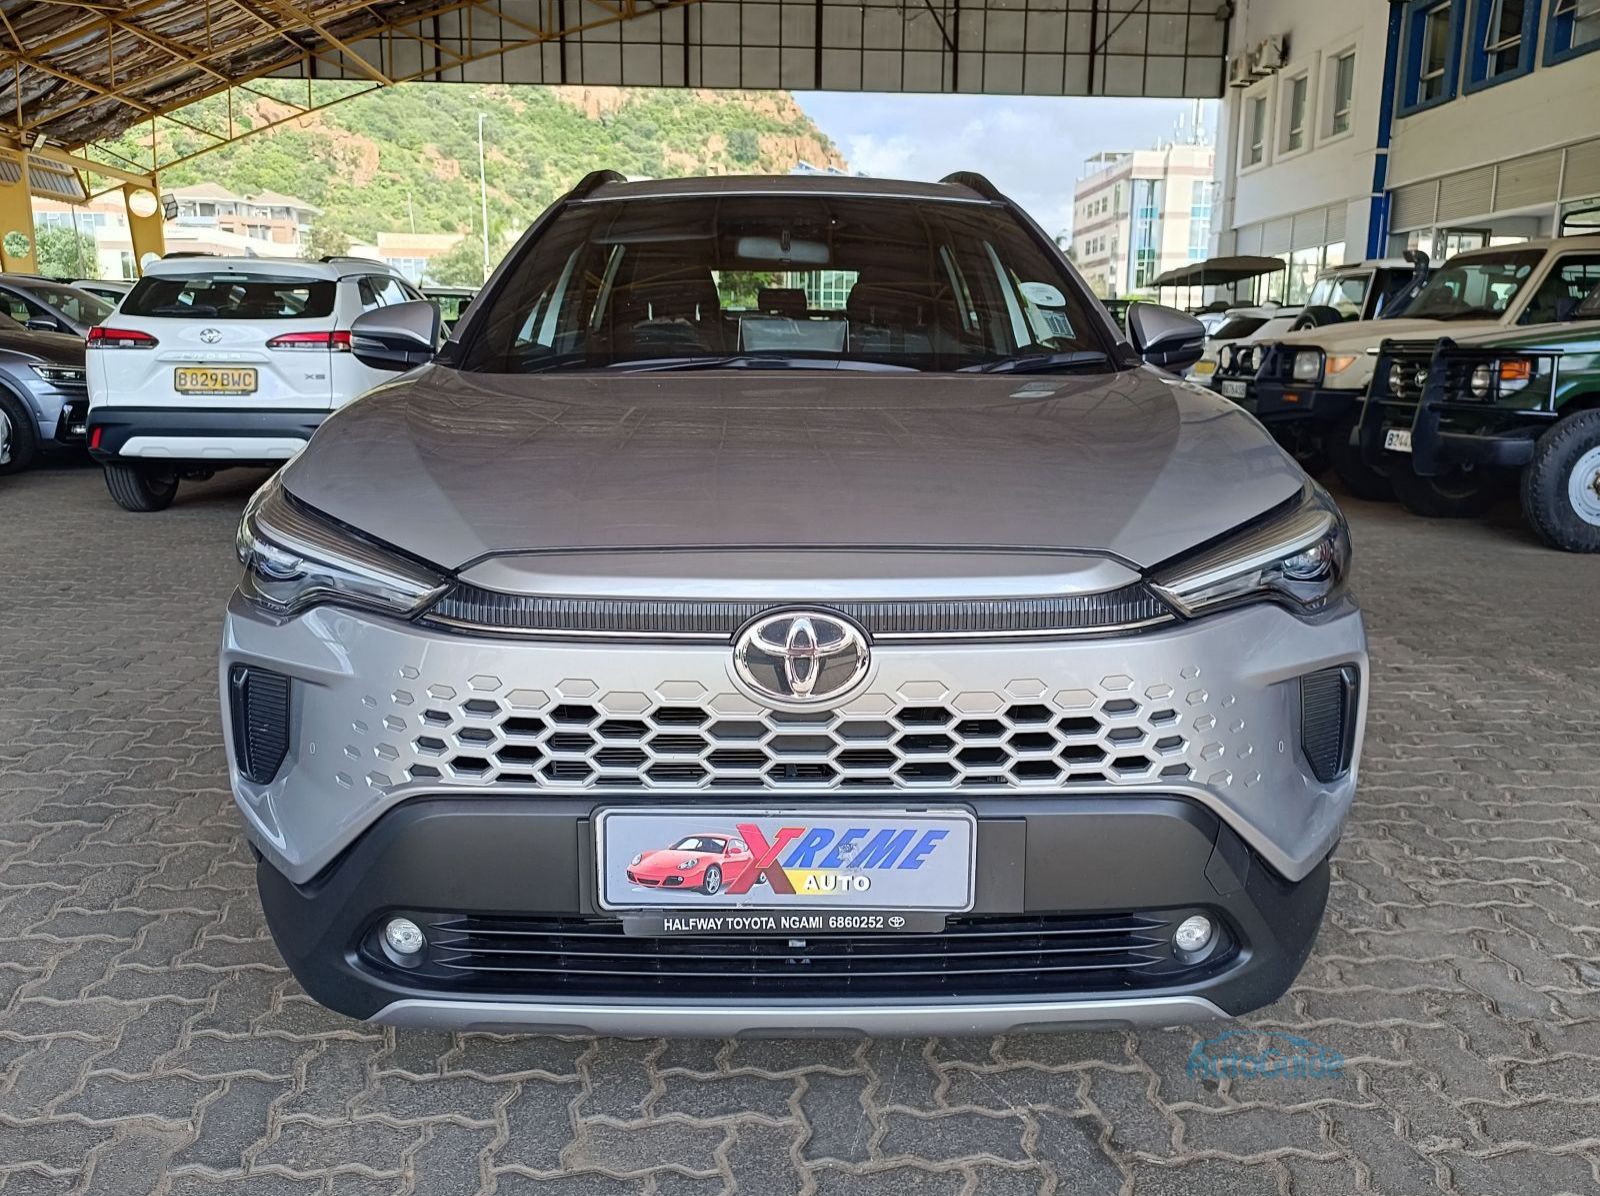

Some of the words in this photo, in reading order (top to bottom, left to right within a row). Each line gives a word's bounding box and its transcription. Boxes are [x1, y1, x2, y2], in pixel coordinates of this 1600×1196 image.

[178, 372, 252, 387] B829BWC
[803, 875, 871, 892] AUTO
[664, 917, 723, 931] HALFWAY
[726, 917, 776, 930] TOYOTA
[781, 916, 822, 929] NGAMI
[829, 916, 884, 929] 6860252
